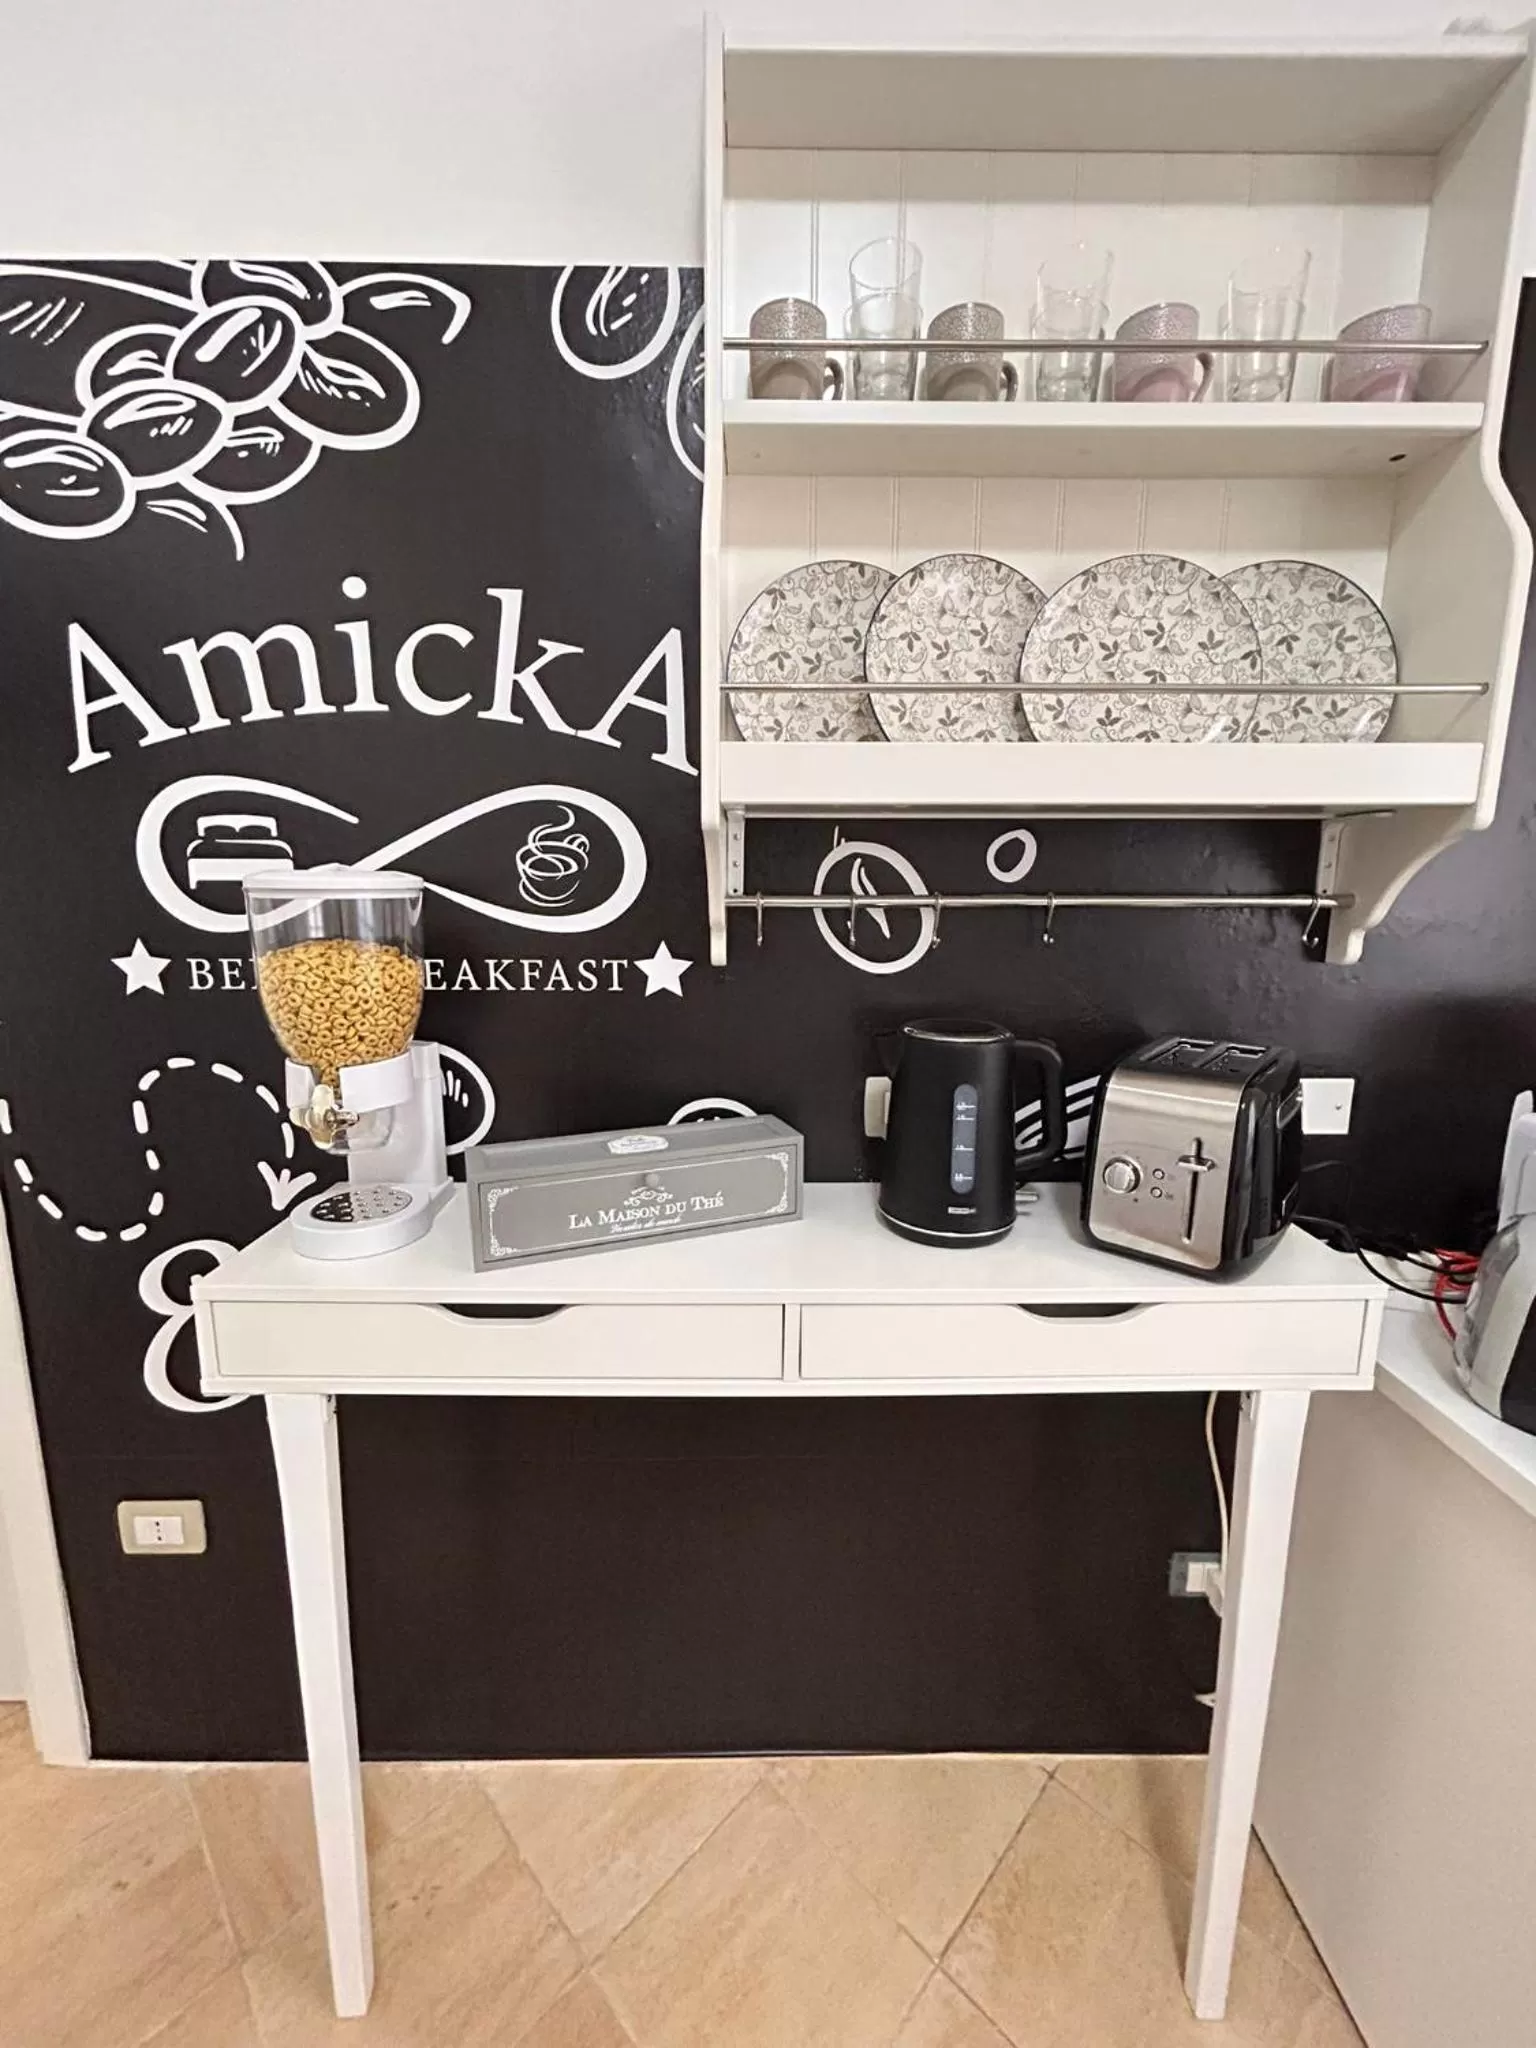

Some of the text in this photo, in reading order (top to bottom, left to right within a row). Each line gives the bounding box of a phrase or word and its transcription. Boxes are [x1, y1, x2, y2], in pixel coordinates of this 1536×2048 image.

[67, 576, 699, 776] AmickA
[187, 957, 628, 992] BE EAKFAST
